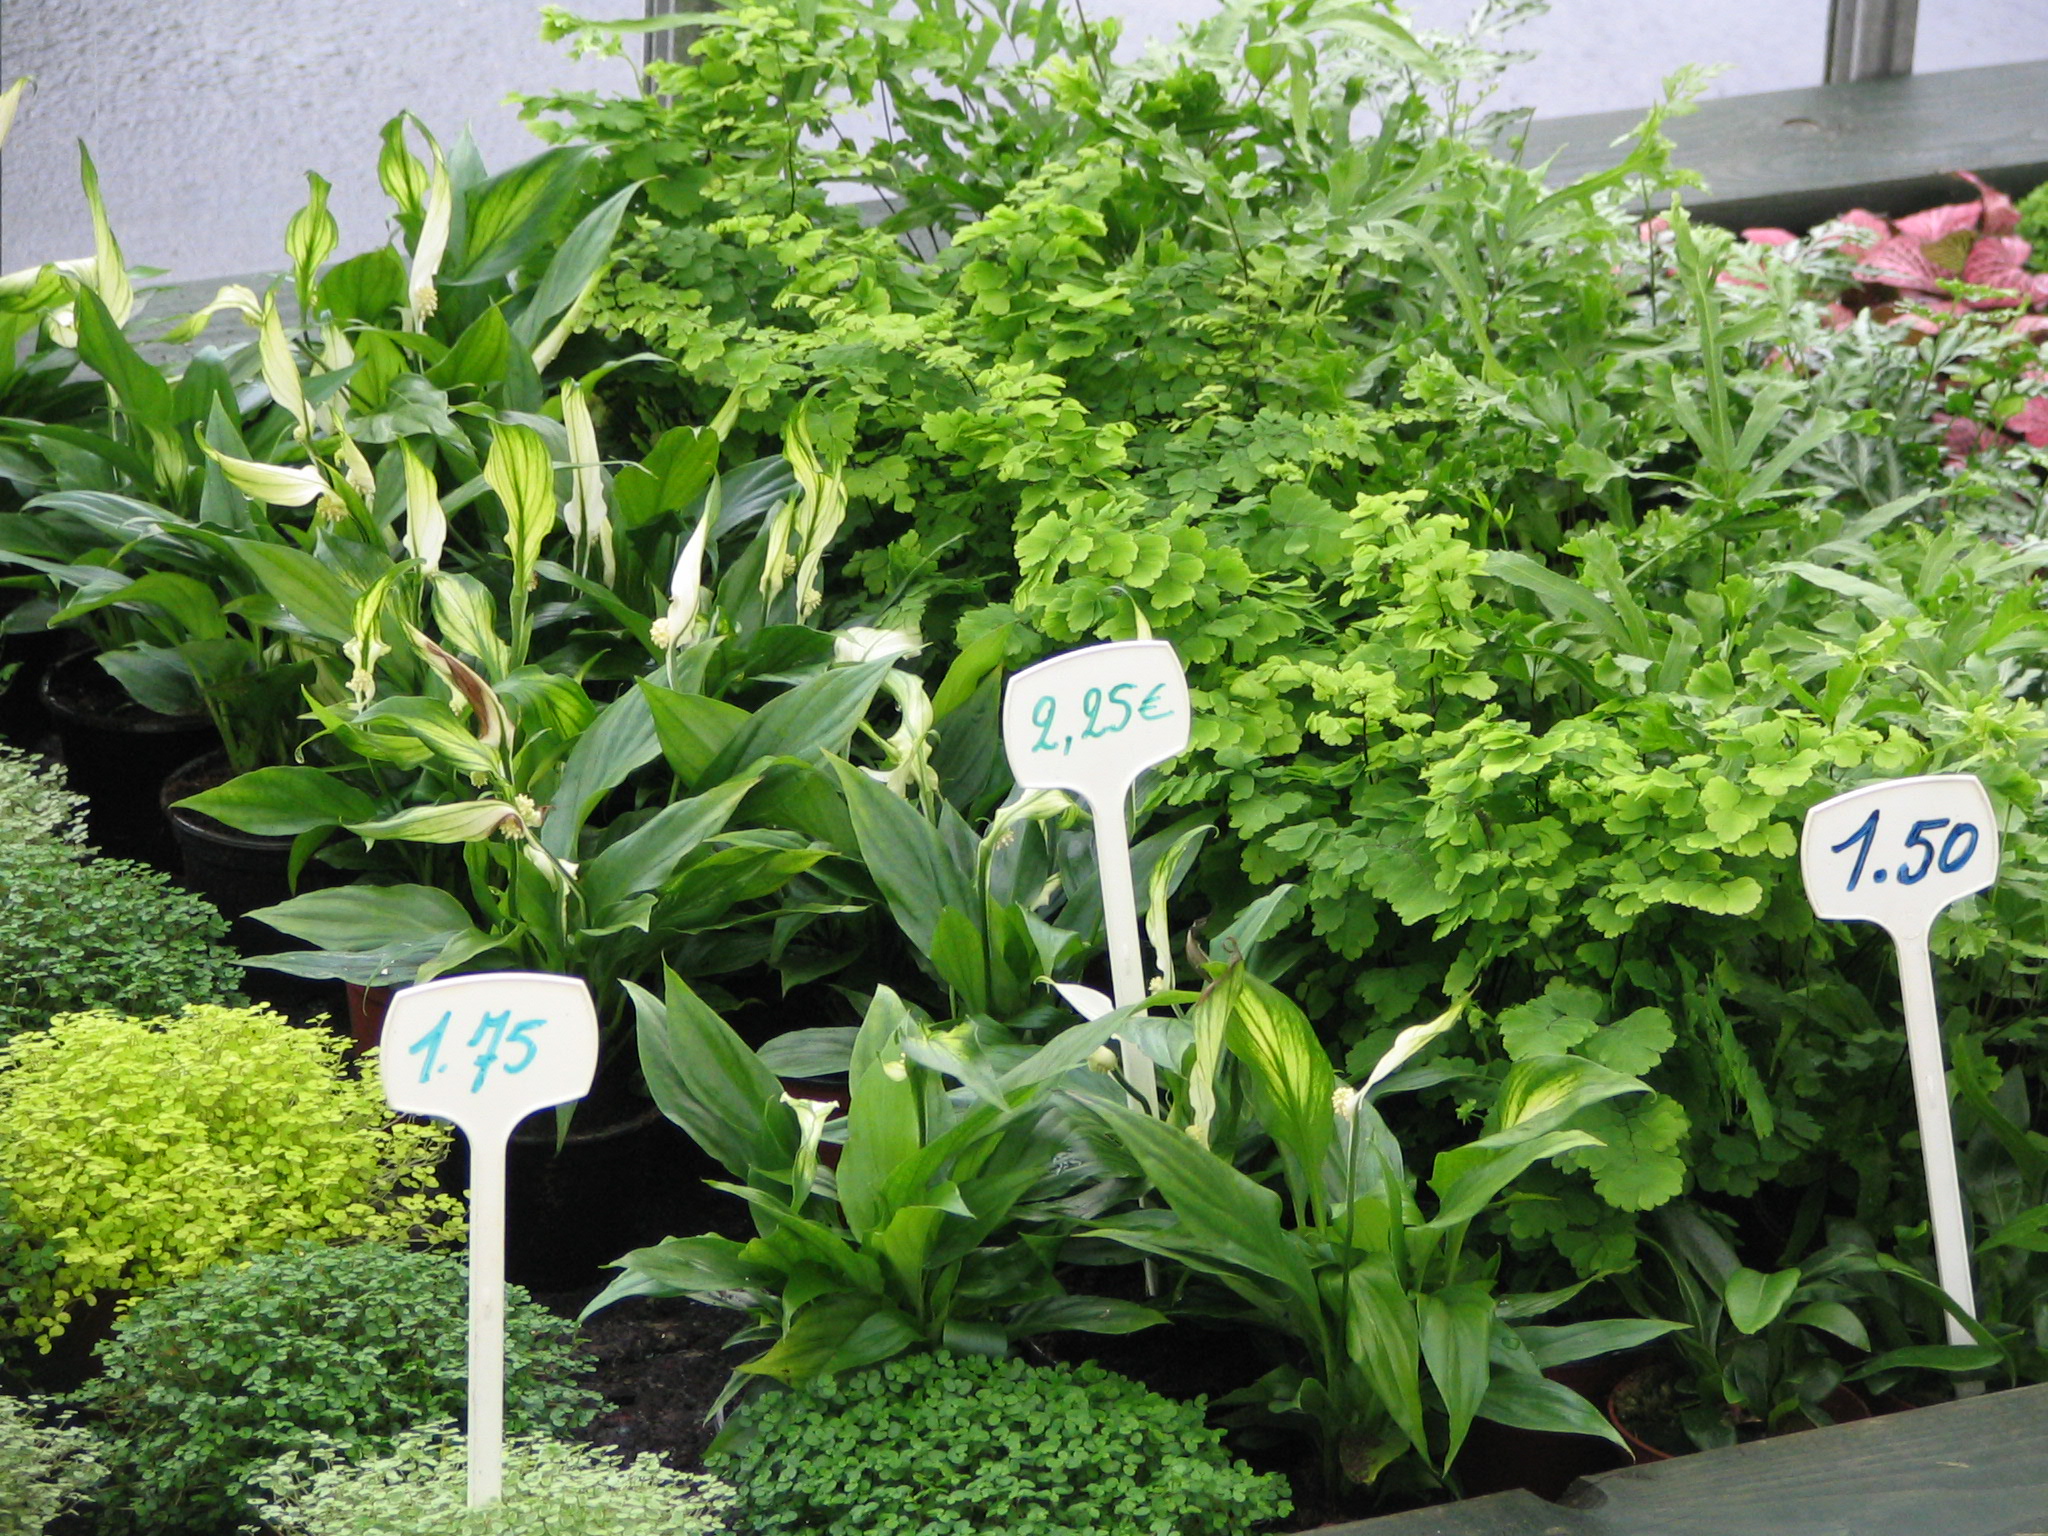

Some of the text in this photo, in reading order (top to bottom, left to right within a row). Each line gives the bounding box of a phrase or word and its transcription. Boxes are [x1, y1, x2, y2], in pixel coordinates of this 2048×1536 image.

[1031, 683, 1175, 756] 2,25€
[1831, 809, 1979, 892] 1.50
[408, 1010, 548, 1094] 1.75
